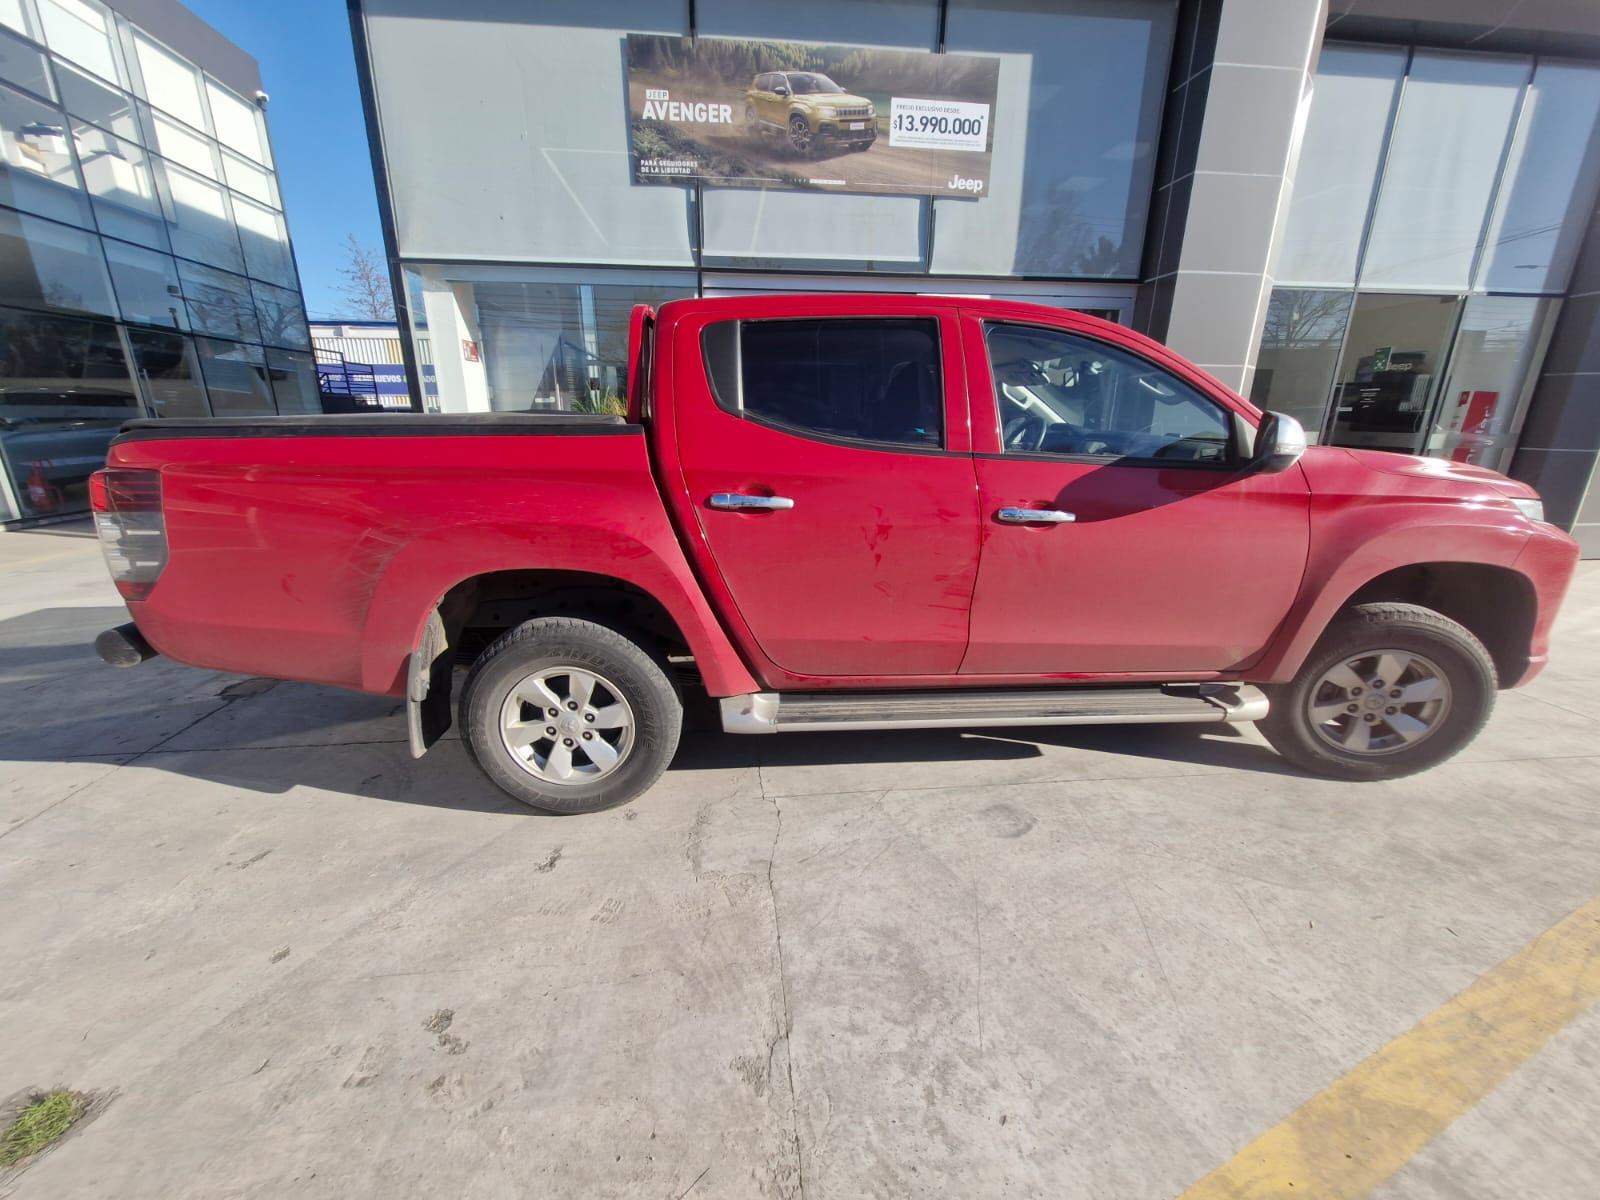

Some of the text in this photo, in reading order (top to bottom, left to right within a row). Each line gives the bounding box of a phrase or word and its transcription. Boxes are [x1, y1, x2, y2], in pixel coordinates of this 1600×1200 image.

[642, 101, 732, 123] AVENGER
[640, 159, 659, 167] PARA
[660, 166, 691, 174] LIBERTAD
[948, 174, 983, 193] Jeep
